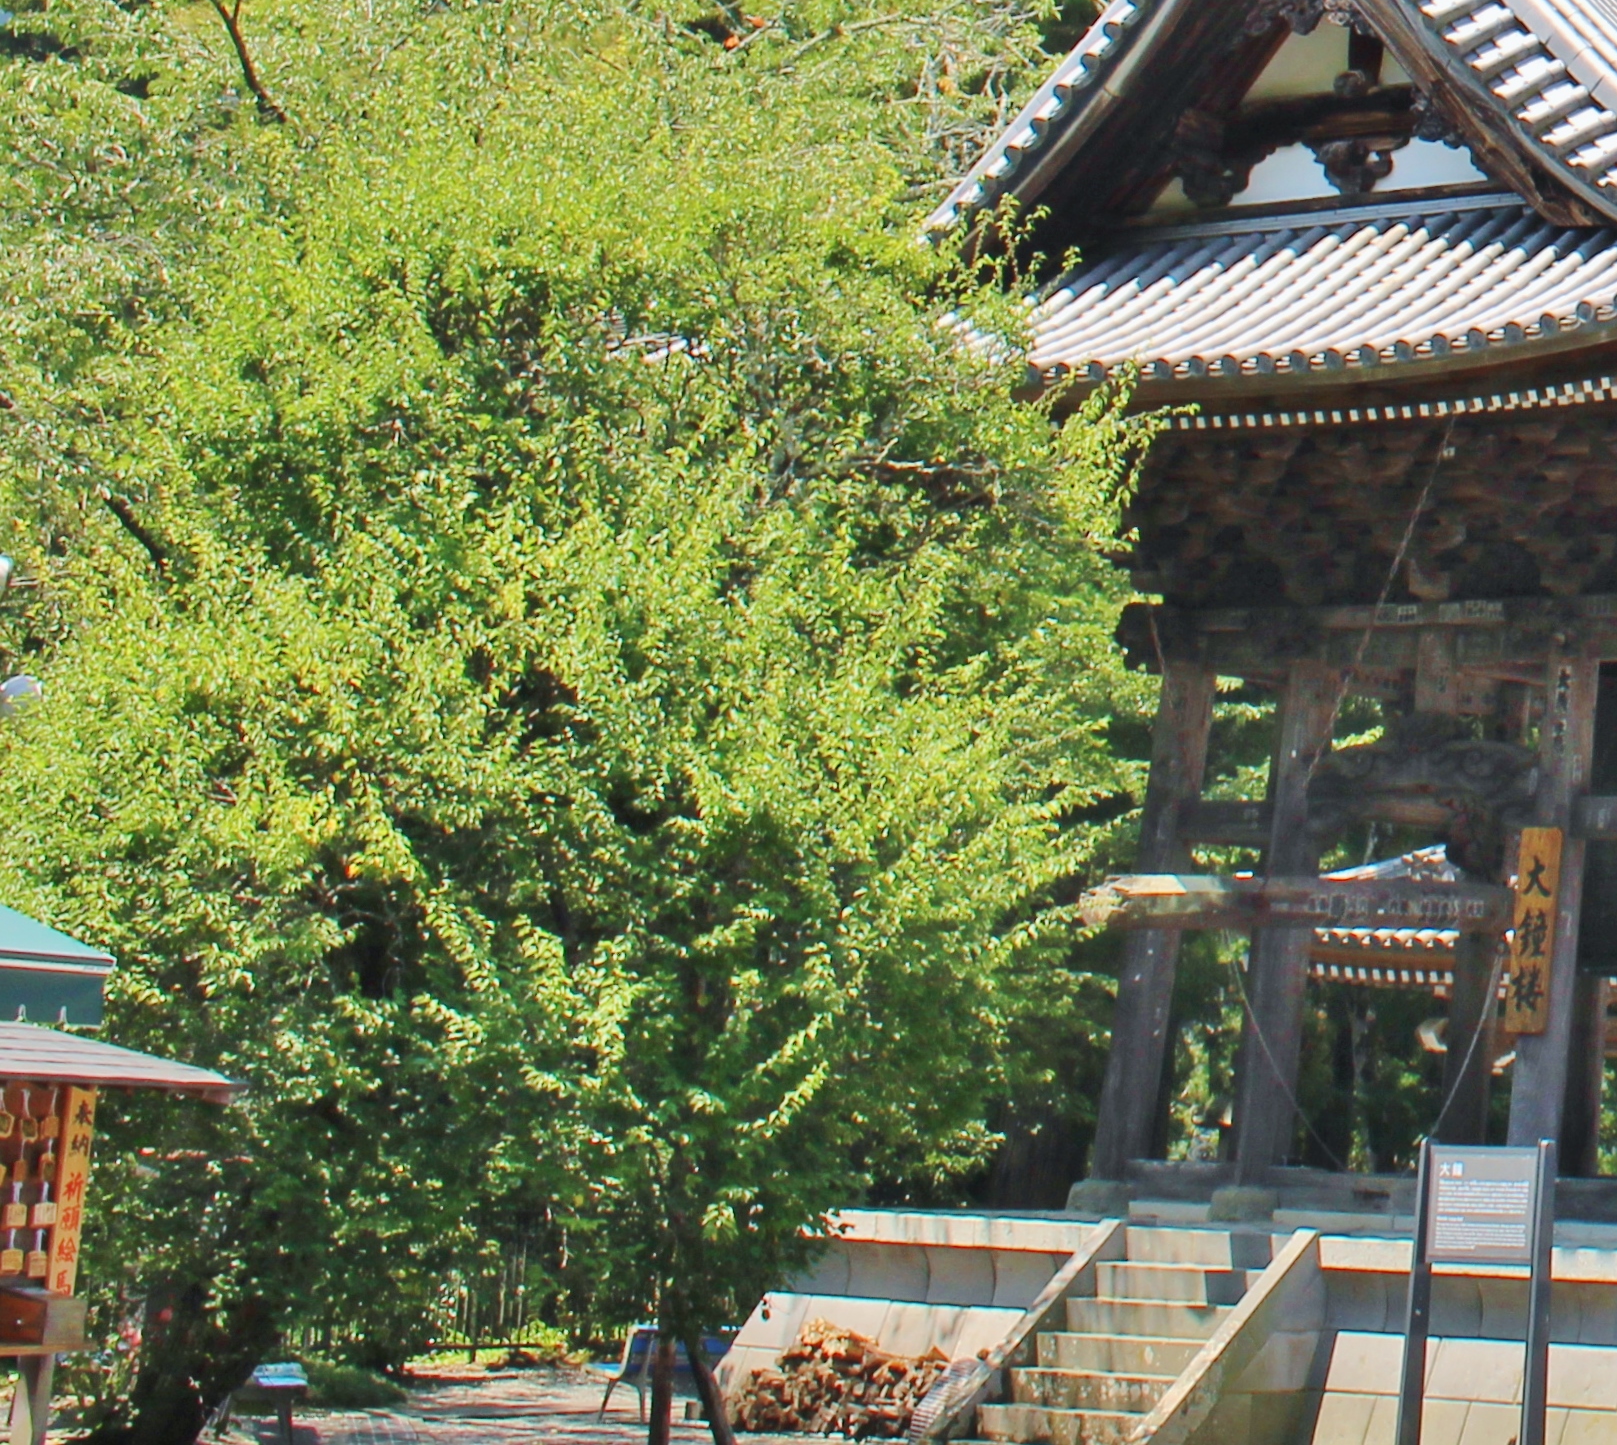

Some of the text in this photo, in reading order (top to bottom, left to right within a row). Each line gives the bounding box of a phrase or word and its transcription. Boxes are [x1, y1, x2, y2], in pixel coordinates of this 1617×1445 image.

[56, 1100, 93, 1296] 奉納 祈願絵馬
